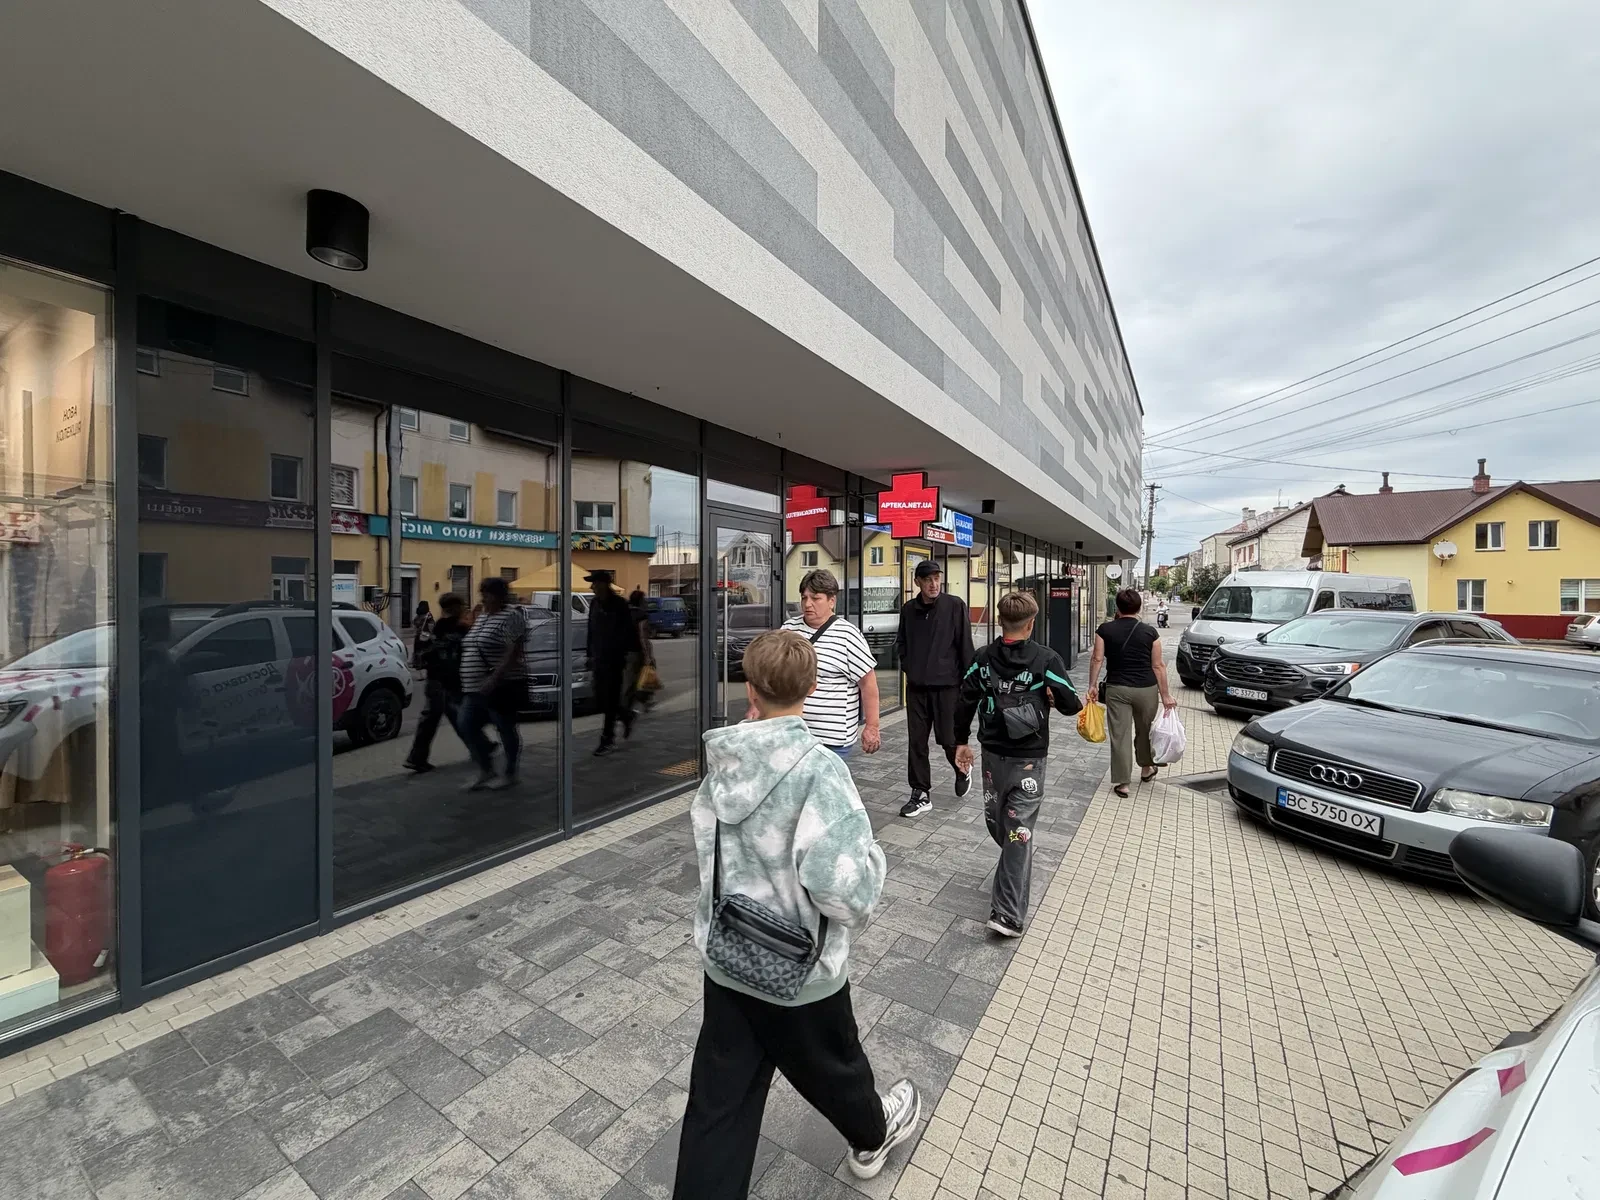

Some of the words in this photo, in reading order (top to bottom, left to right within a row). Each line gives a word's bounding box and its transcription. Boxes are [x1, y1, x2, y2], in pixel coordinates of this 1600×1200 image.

[63, 404, 77, 421] НОВА
[1230, 687, 1239, 695] BC
[1241, 689, 1255, 698] 3372
[1286, 793, 1307, 811] BC
[1311, 801, 1347, 822] 5750
[1351, 813, 1376, 832] OX
